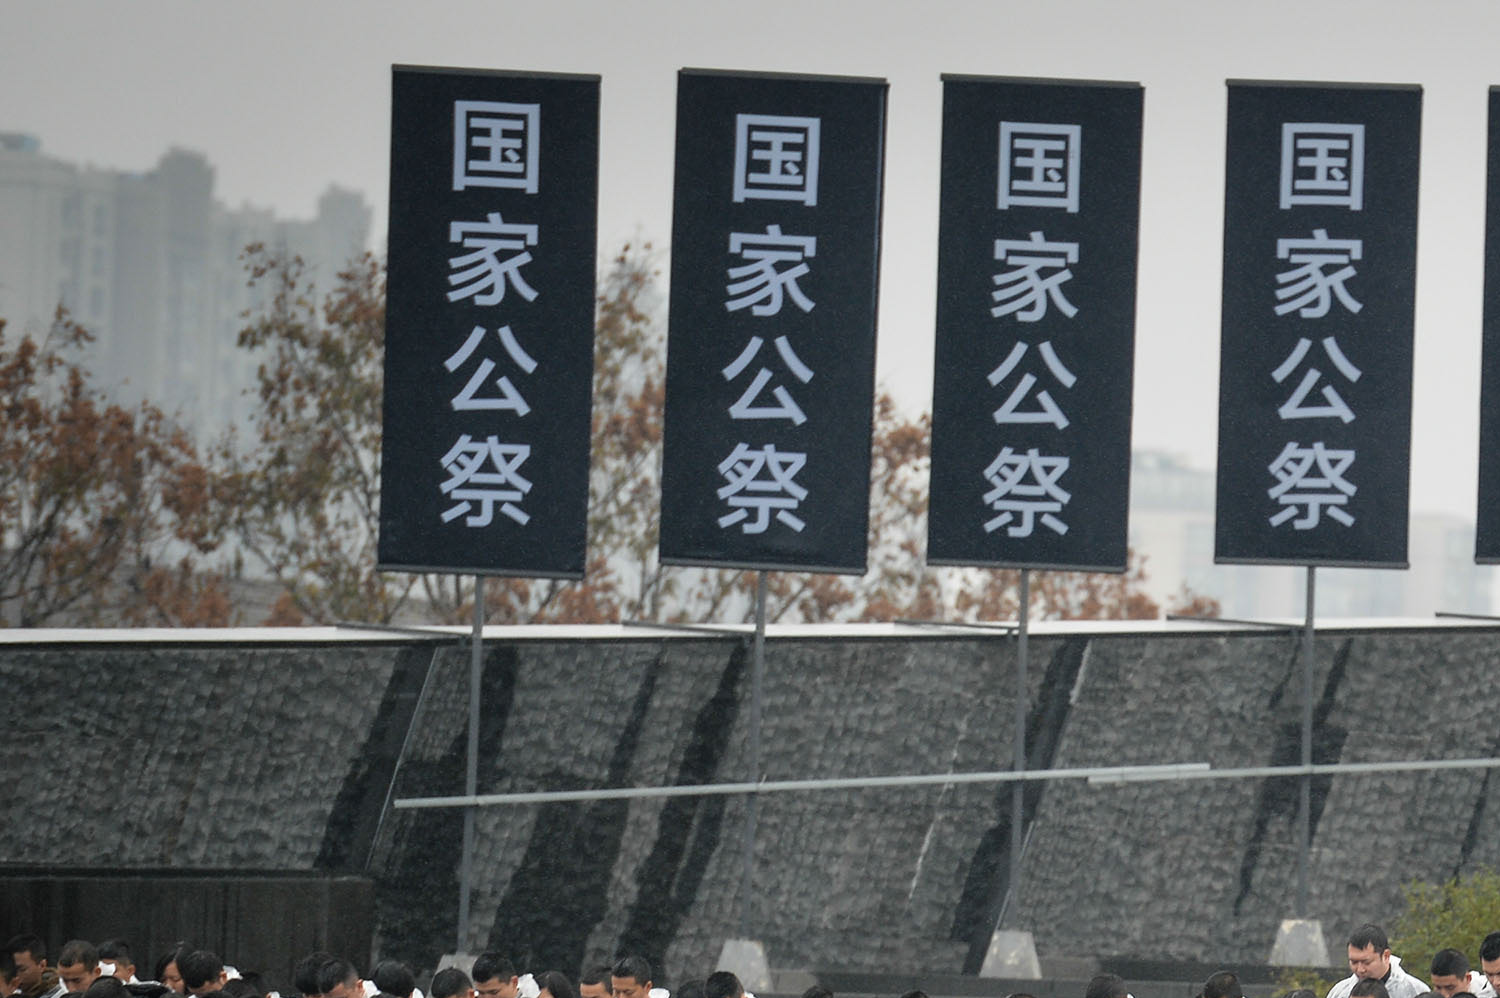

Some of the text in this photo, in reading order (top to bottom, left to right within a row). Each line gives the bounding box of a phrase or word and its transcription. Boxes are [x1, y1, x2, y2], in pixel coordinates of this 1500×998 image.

[440, 100, 541, 527] 国家公祭
[717, 113, 820, 534] 国家公祭
[983, 121, 1081, 538] 国家公祭
[1268, 121, 1365, 530] 国家公祭
